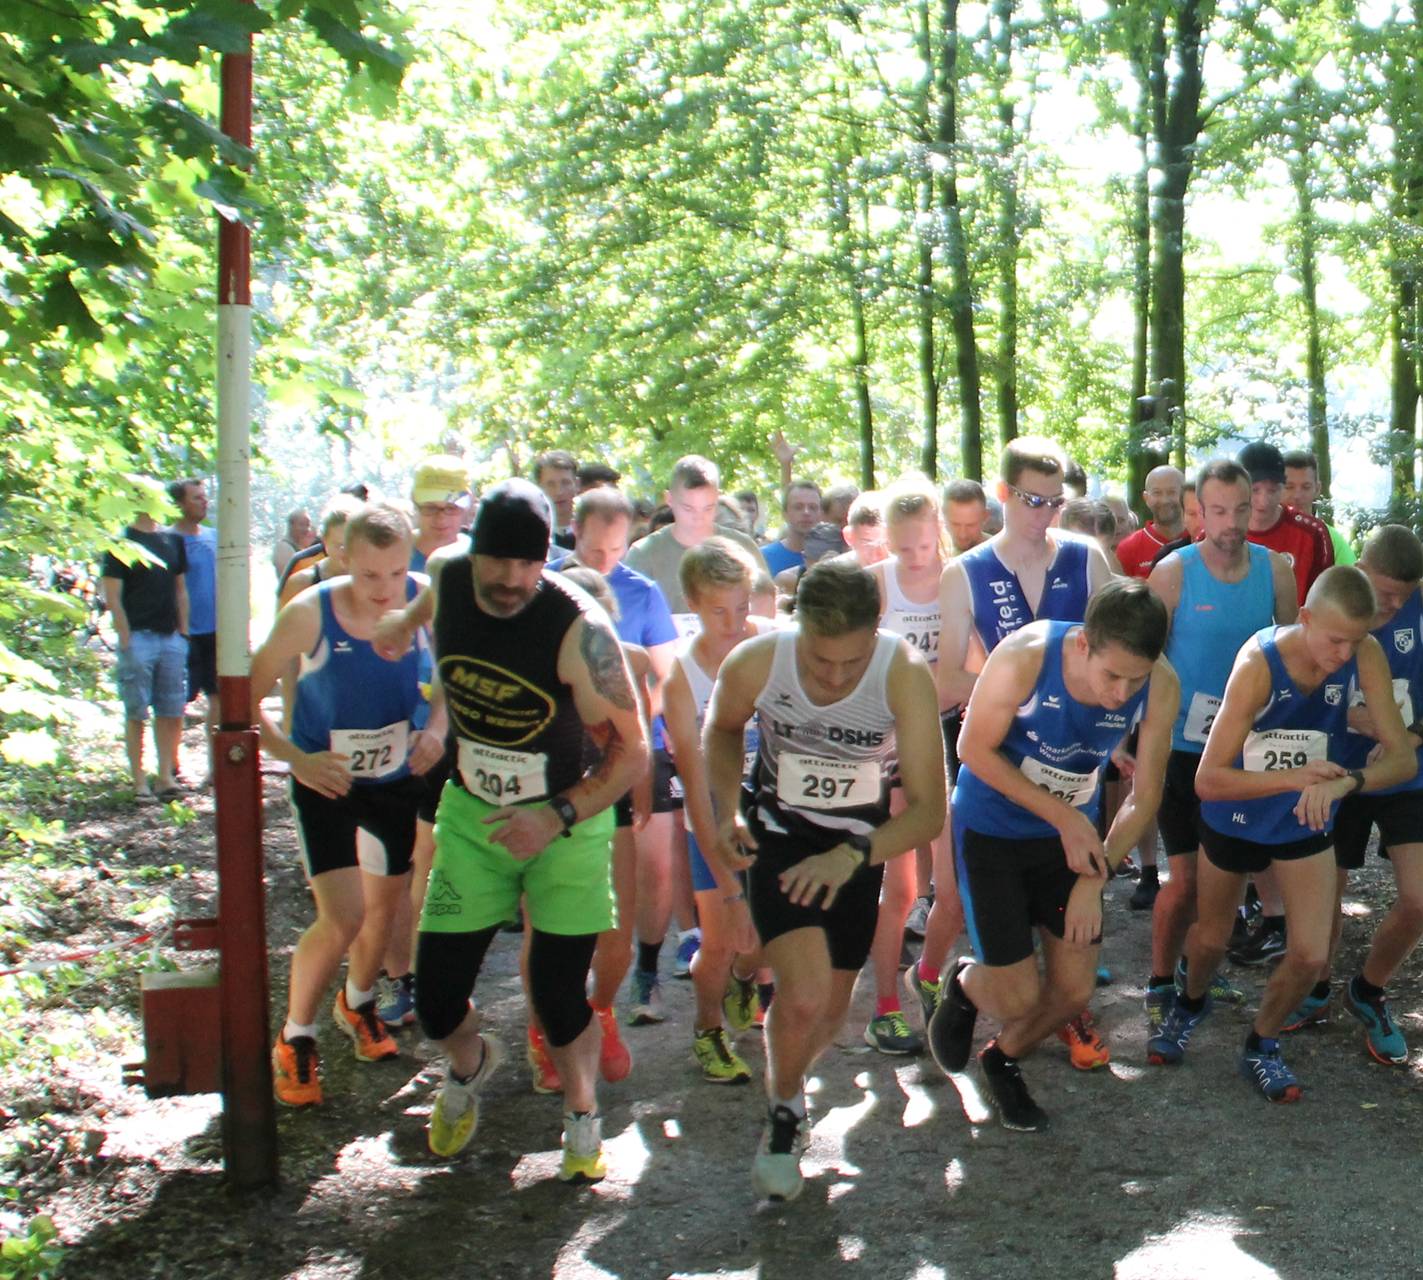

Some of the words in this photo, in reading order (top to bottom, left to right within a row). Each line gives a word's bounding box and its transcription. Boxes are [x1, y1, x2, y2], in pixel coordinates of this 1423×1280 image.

[905, 631, 939, 652] 247
[451, 666, 522, 701] MSF
[773, 720, 795, 738] LT
[828, 727, 884, 746] DSHS
[1262, 732, 1311, 741] attractic
[351, 745, 392, 771] 272
[473, 748, 528, 764] attractic
[1264, 750, 1308, 771] 259
[475, 768, 521, 797] 204
[802, 774, 856, 798] 297
[1232, 812, 1247, 824] HL
